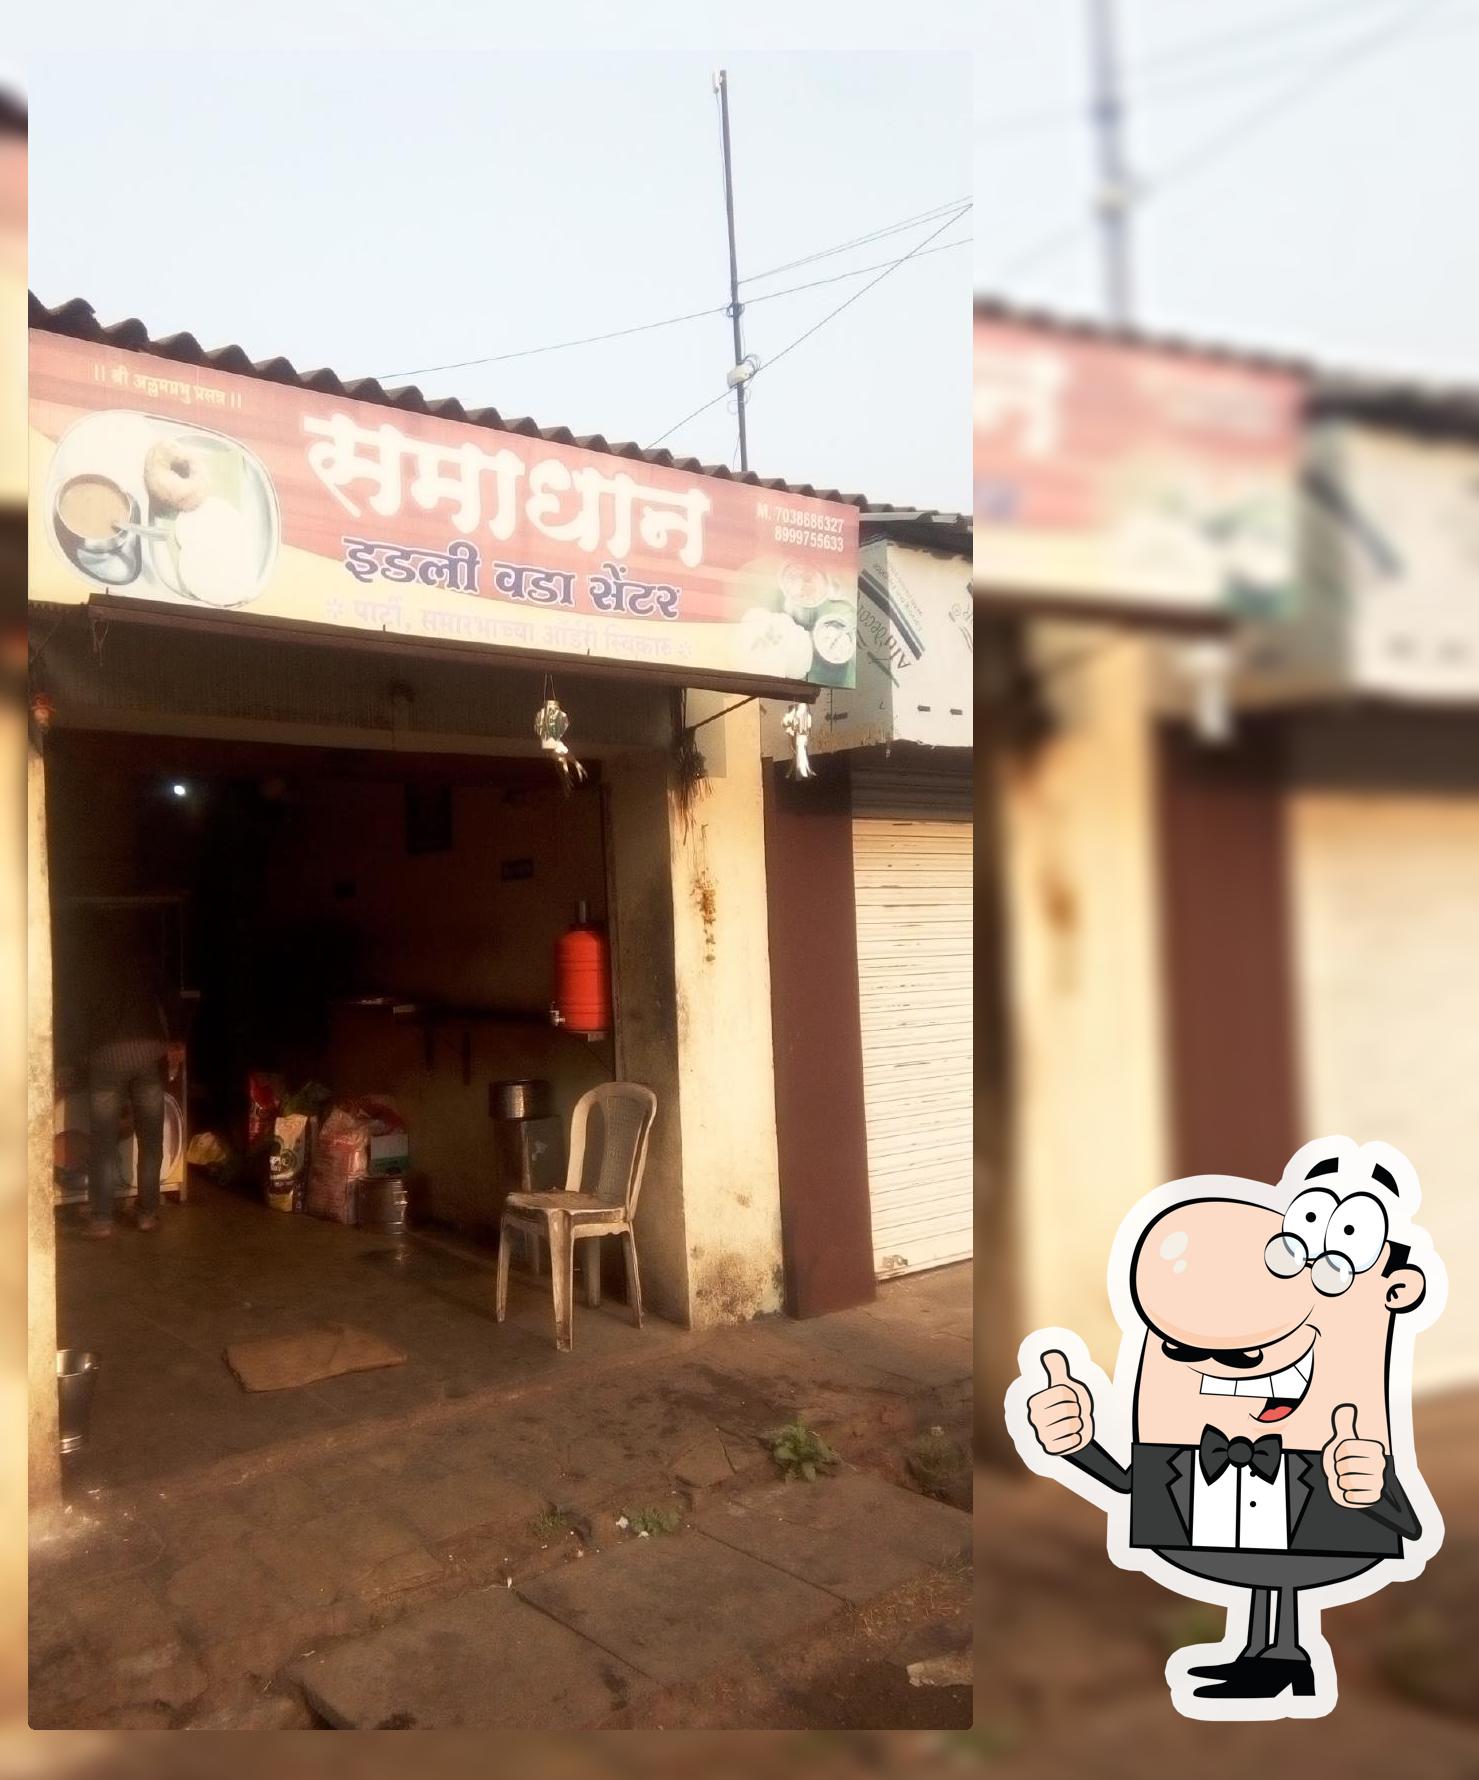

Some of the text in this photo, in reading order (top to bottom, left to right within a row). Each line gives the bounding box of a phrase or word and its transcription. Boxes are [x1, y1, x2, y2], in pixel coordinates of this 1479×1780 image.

[111, 365, 129, 385] श्री
[303, 412, 712, 568] समाधान
[775, 506, 845, 534] 7038686327
[774, 525, 844, 553] 8999755633
[342, 538, 681, 620] इडली वडा सेंटर
